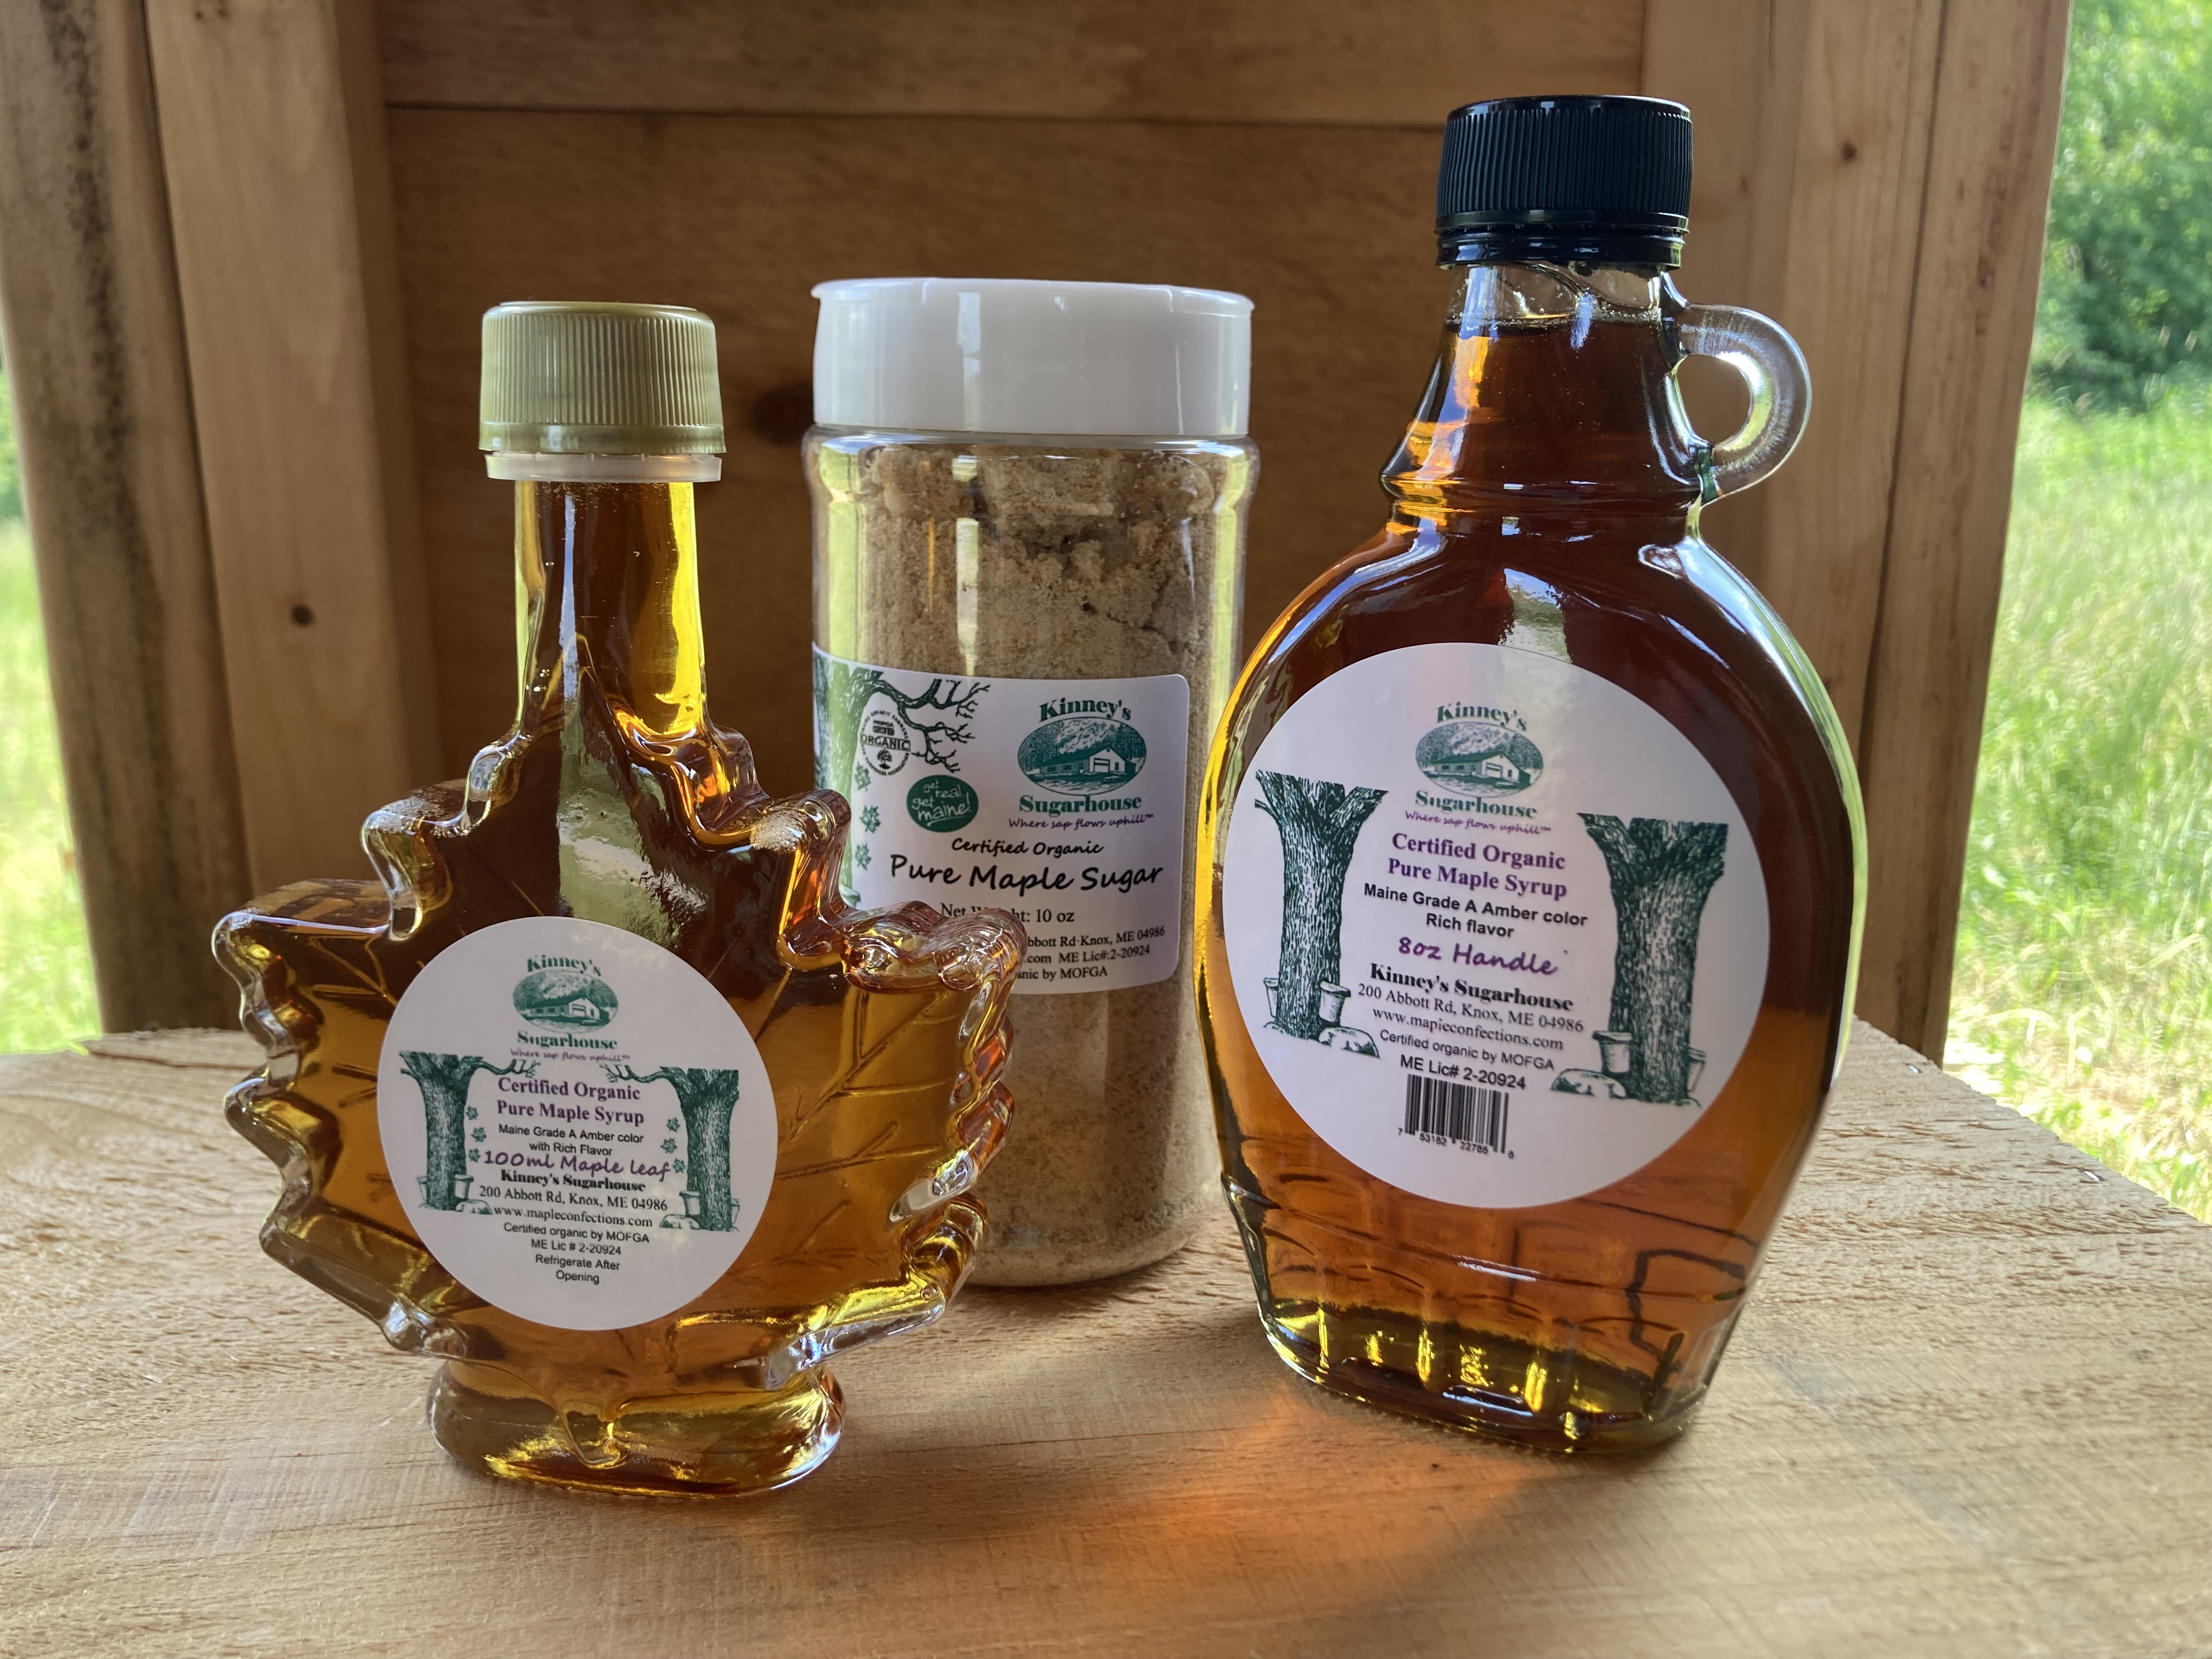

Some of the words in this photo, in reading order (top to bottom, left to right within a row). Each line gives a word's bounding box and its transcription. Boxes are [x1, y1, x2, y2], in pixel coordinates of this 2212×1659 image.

[1039, 697, 1131, 723] Kinney's
[1437, 702, 1527, 732] Kinney's
[861, 735, 910, 750] ORGANIC
[923, 779, 939, 793] get
[912, 795, 935, 810] get
[918, 792, 972, 821] maine!
[1019, 795, 1142, 817] Sugarhouse
[1415, 789, 1537, 819] Sugarhouse
[1008, 818, 1047, 828] Where
[1051, 821, 1072, 830] sap
[1074, 818, 1106, 830] flows
[1405, 810, 1442, 823] Where
[1443, 817, 1464, 827] sap
[1465, 818, 1497, 830] flows
[951, 837, 1029, 857] Certified
[1032, 840, 1104, 858] Organic
[1392, 832, 1476, 860] Certified
[1483, 845, 1565, 870] Organic
[890, 854, 962, 884] Pure
[968, 865, 1075, 897] Maple
[1080, 865, 1164, 893] Sugar
[1388, 857, 1432, 880] Pure
[1437, 865, 1499, 890] Maple
[1505, 874, 1567, 901] Syrup
[940, 902, 967, 917] Net
[1036, 909, 1052, 923] 10
[1056, 911, 1075, 922] oz
[1364, 883, 1408, 902] Maine
[1413, 891, 1460, 910] Grade
[1465, 900, 1477, 913] A
[1482, 902, 1538, 921] Amber
[1543, 911, 1588, 927] color
[1028, 936, 1057, 947] bbott
[1115, 931, 1135, 944] ME
[1137, 925, 1165, 940] 04986
[1426, 913, 1462, 931] Rich
[1467, 919, 1515, 938] flavor
[527, 955, 601, 977] Kinney's
[1058, 952, 1080, 964] ME
[1398, 936, 1442, 961] 8oz
[1453, 943, 1559, 975] Handle
[1042, 968, 1057, 982] by
[1060, 966, 1108, 979] MOFGA
[1370, 962, 1449, 994] Kinney's
[1454, 978, 1574, 1012] Sugarhouse
[1358, 983, 1381, 998] 200
[1386, 990, 1429, 1009] Abbott
[1434, 1000, 1457, 1014] Rd,
[1462, 1003, 1503, 1023] Knox,
[1508, 1011, 1534, 1027] ME
[1538, 1014, 1584, 1032] 04986
[517, 1030, 618, 1049] Sugarhouse
[1380, 1029, 1429, 1049] Certified
[1432, 1042, 1479, 1059] organic
[1482, 1049, 1497, 1064] by
[1501, 1052, 1554, 1070] MOFGA
[510, 1048, 540, 1057] Where
[1401, 1054, 1424, 1071] ME
[1429, 1060, 1459, 1077] Lic#
[1463, 1067, 1526, 1090] 2-20924
[498, 1077, 569, 1096] Certified
[574, 1082, 641, 1102] Organic
[497, 1100, 535, 1116] Pure
[540, 1103, 590, 1123] Maple
[595, 1106, 645, 1127] Syrup
[499, 1124, 530, 1136] Maine
[533, 1126, 566, 1138] Grade
[568, 1129, 577, 1139] A
[580, 1130, 615, 1142] Amber
[617, 1133, 644, 1143] color
[1398, 1127, 1403, 1136] 7
[1420, 1133, 1447, 1147] 53182
[529, 1142, 550, 1152] with
[554, 1143, 577, 1153] Rich
[580, 1144, 613, 1156] Flavor
[484, 1150, 555, 1169] 100ml
[560, 1155, 624, 1178] Maple
[630, 1159, 672, 1182] leaf
[501, 1169, 560, 1187] Kinney's
[563, 1174, 646, 1192] Sugarhouse
[479, 1186, 501, 1198] 200
[505, 1189, 543, 1202] Abbott
[546, 1191, 566, 1205] Rd,
[569, 1193, 603, 1207] Knox,
[607, 1195, 628, 1209] ME
[631, 1198, 668, 1211] 04986
[494, 1206, 653, 1227] www.mapleconfections.com
[504, 1222, 546, 1235] Certified
[550, 1227, 588, 1239] organic
[591, 1230, 603, 1242] by
[606, 1231, 650, 1243] MOFGA
[531, 1238, 548, 1250] ME
[551, 1240, 567, 1251] Lic
[569, 1242, 576, 1252] #
[579, 1243, 622, 1255] 2-20924
[535, 1254, 592, 1268] Refrigerate
[595, 1260, 620, 1271] After
[556, 1269, 600, 1285] Opening
